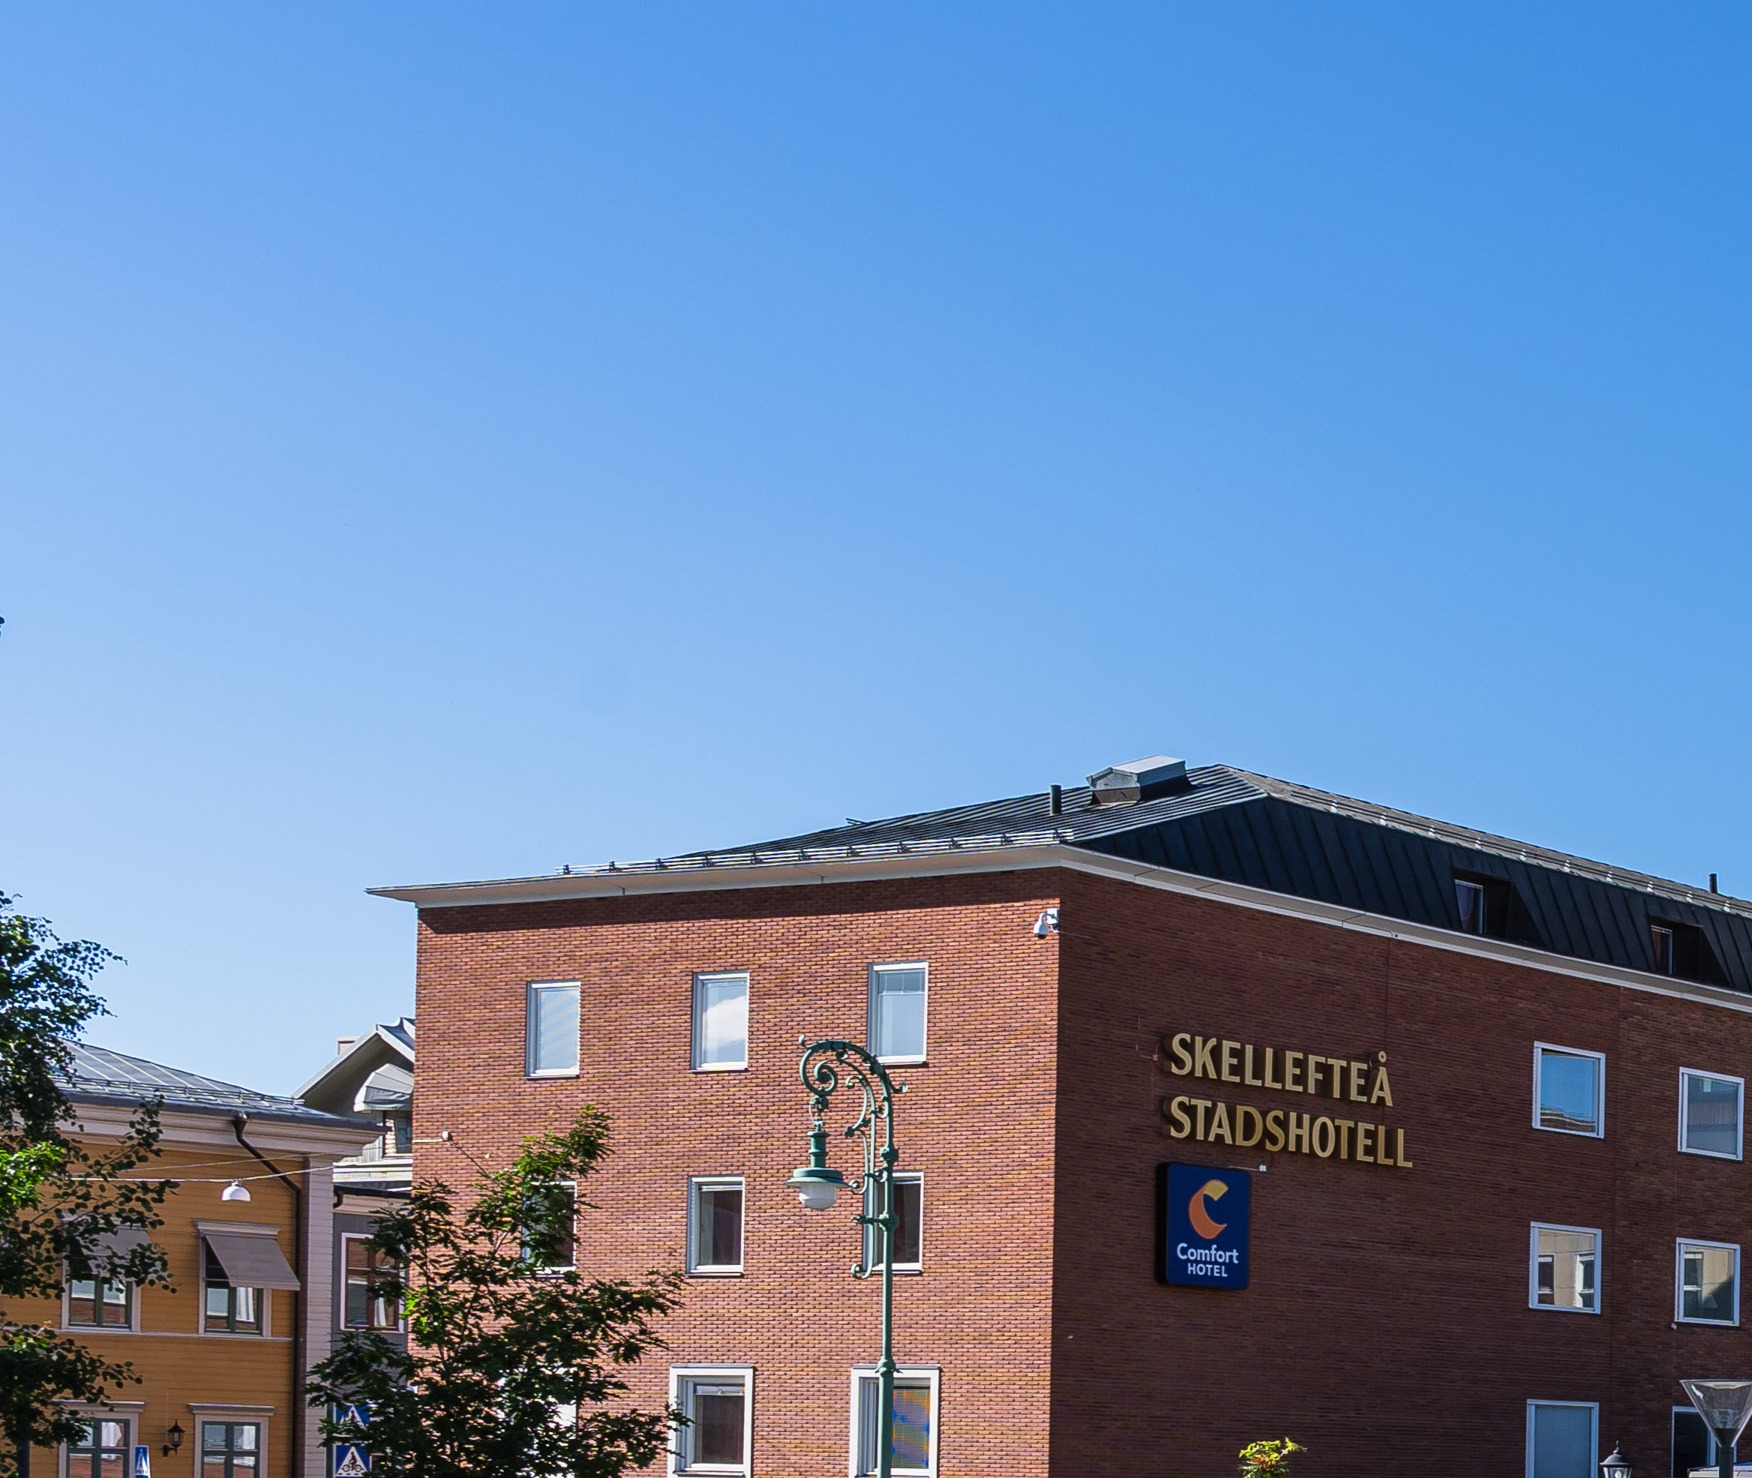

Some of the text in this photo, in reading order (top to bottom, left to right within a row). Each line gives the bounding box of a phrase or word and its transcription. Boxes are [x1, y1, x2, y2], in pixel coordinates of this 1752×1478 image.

[1169, 1032, 1393, 1107] SKELLEFTEÅ
[1169, 1095, 1413, 1168] STADSHOTELL
[1176, 1242, 1239, 1264] Comfort
[1187, 1262, 1228, 1278] HOTEL
